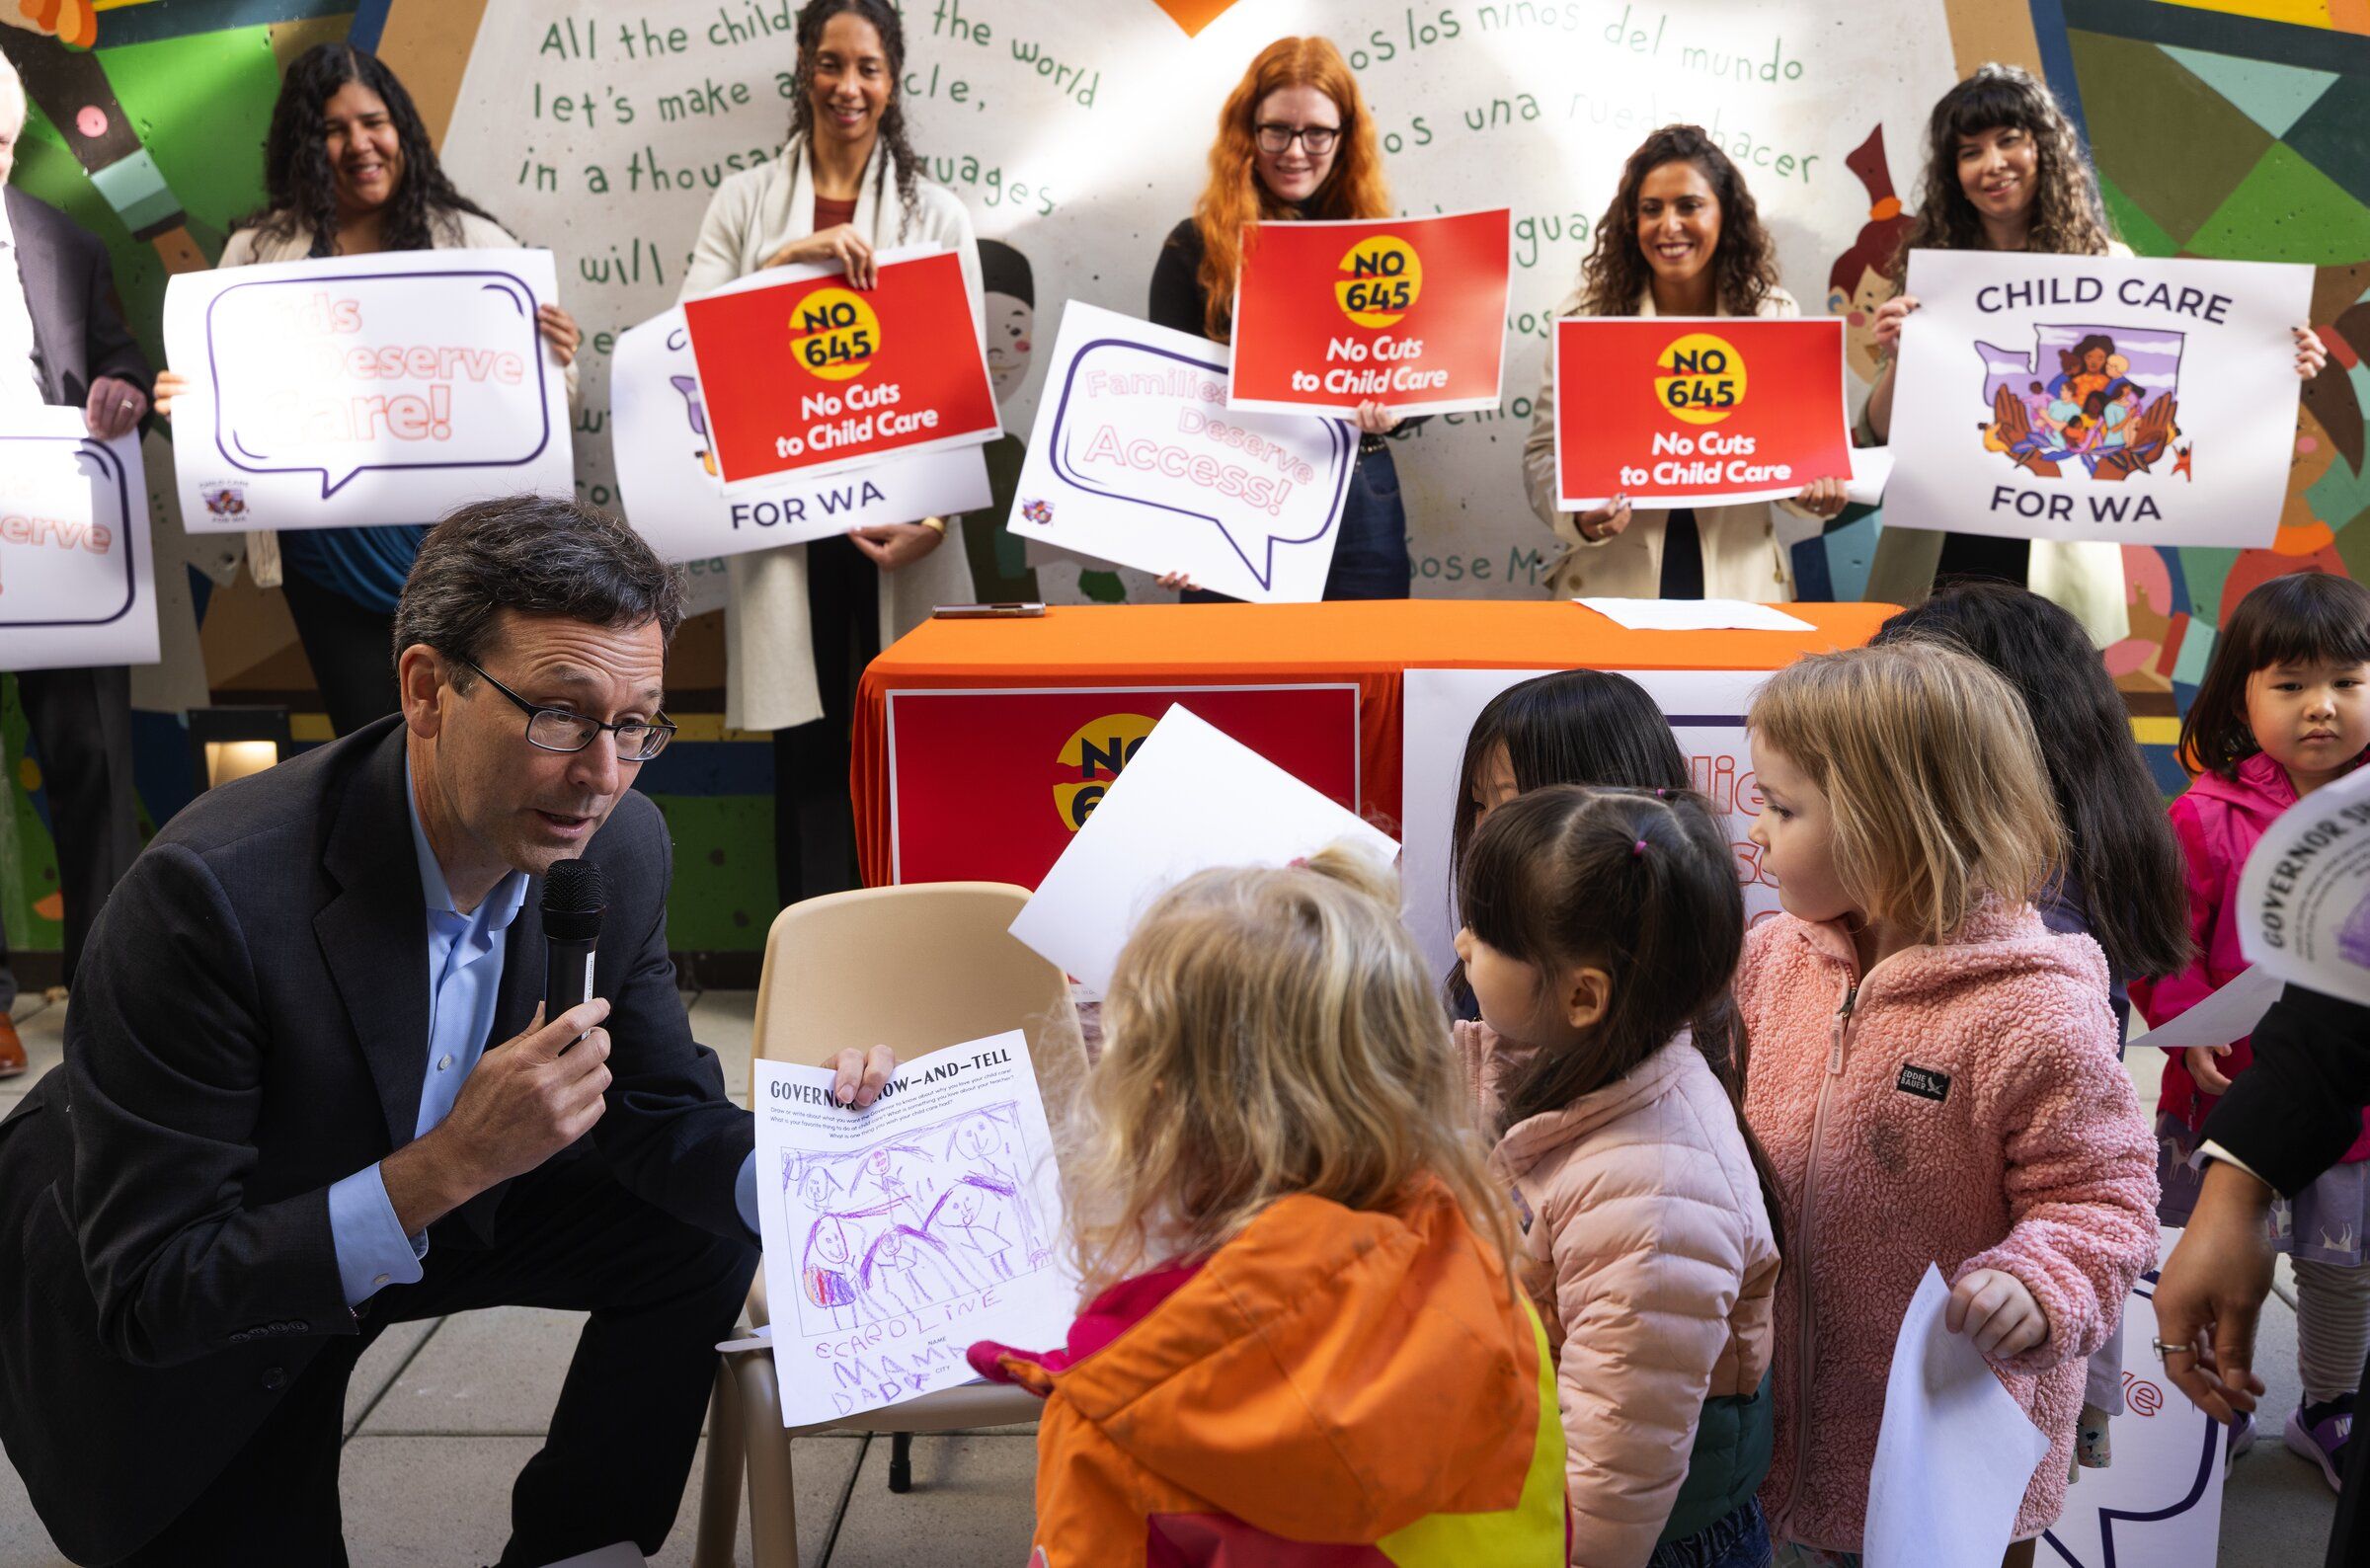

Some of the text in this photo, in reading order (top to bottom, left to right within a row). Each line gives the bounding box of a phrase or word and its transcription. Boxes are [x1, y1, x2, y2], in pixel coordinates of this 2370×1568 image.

[540, 17, 595, 60] All
[618, 18, 687, 59] the
[933, 0, 1101, 109] the world
[1406, 8, 1461, 50] los
[1605, 4, 1667, 55] del
[1682, 36, 1803, 83] mundo
[534, 71, 796, 128] let's make a
[1464, 94, 1541, 130] una
[1709, 107, 1820, 184] hacer
[518, 146, 558, 192] in
[584, 164, 609, 195] a
[580, 237, 665, 286] will
[1354, 251, 1406, 278] NO
[1346, 281, 1410, 312] 645
[1976, 275, 2233, 325] CHILD CARE
[803, 302, 856, 334] NO
[805, 330, 872, 366] 645
[1326, 336, 1423, 361] No Cuts
[1673, 350, 1727, 375] NO
[1292, 366, 1448, 395] to Child Care
[1667, 380, 1735, 408] 645
[802, 383, 901, 421] No Cuts
[776, 408, 939, 458] to Child Care
[1178, 406, 1315, 486] Deserve
[1652, 431, 1756, 456] No Cuts
[1083, 425, 1293, 517] Access!
[1620, 460, 1792, 485] to Child Care
[731, 481, 886, 529] FOR WA
[1990, 485, 2163, 523] FOR WA
[0, 513, 112, 555] erve
[2261, 821, 2348, 950] GOVERNOR
[1900, 1076, 1926, 1090] BAUER
[1903, 1069, 1927, 1083] EDDIE
[870, 1104, 895, 1117] Governor
[927, 1336, 947, 1346] NAME
[935, 1366, 951, 1374] CITY
